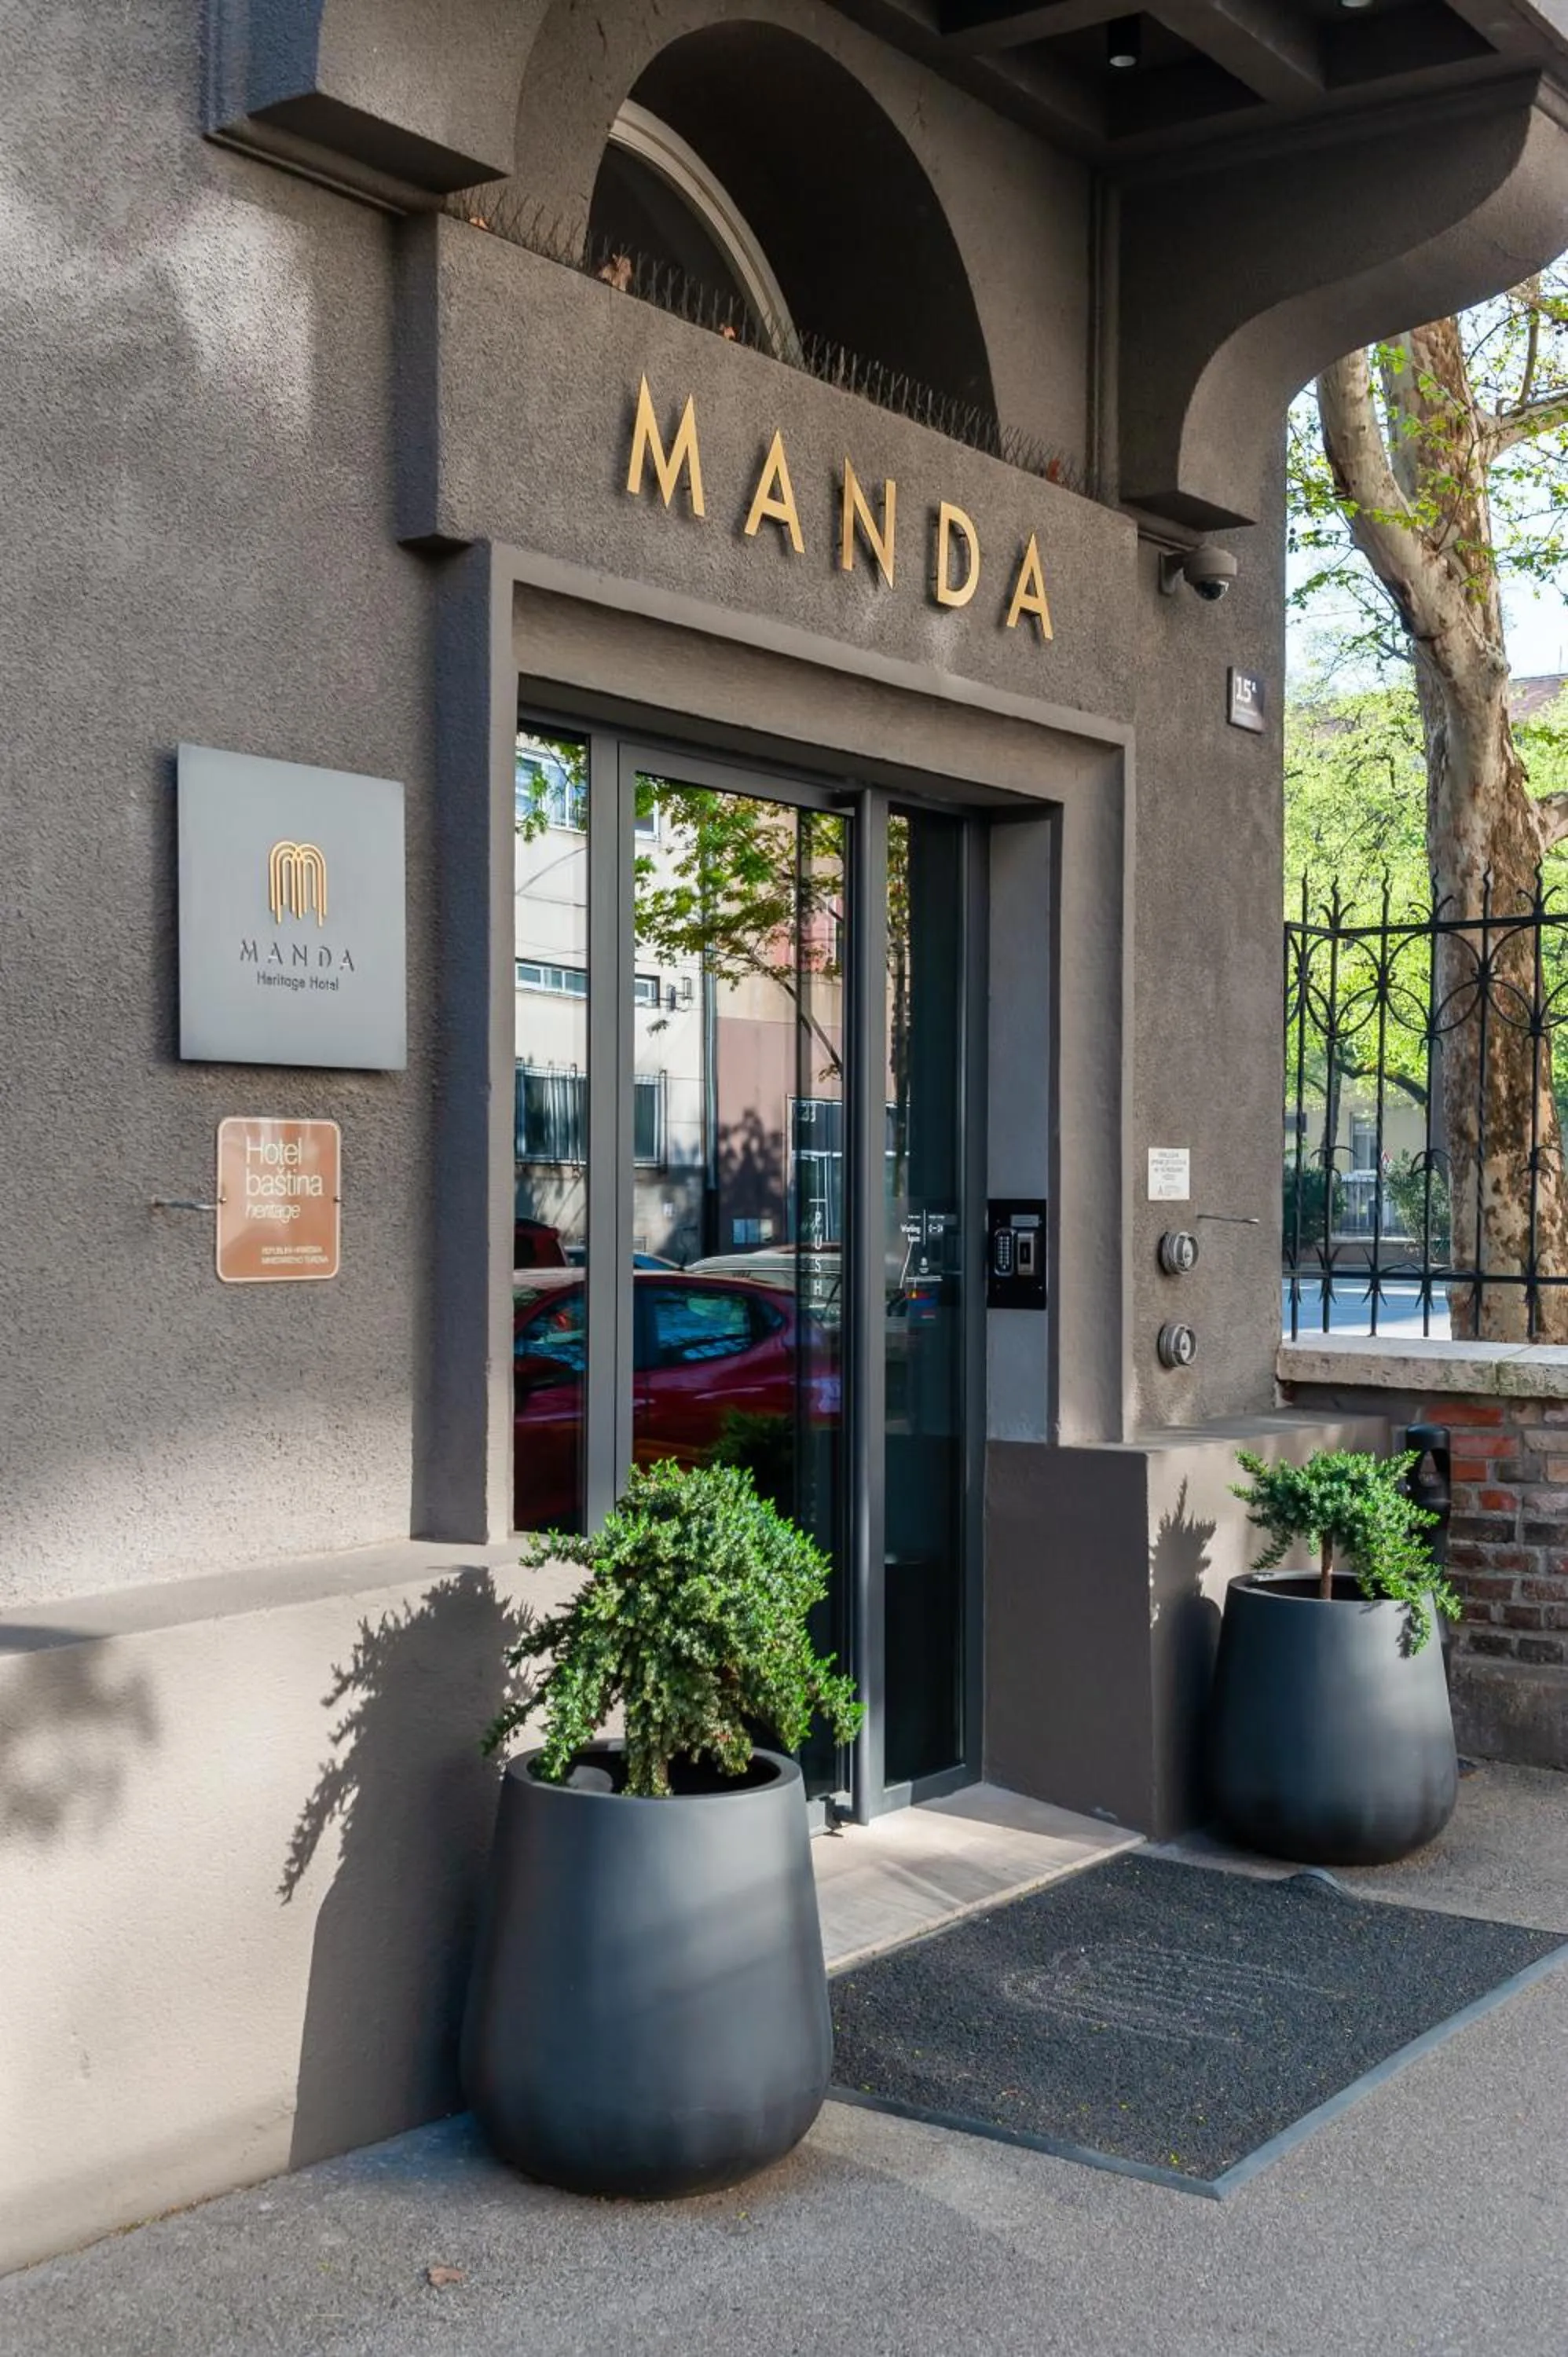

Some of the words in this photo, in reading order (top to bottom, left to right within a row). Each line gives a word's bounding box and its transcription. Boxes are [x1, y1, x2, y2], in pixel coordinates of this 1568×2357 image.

[625, 372, 1055, 642] MANDA
[239, 938, 356, 973] MANDA
[256, 971, 306, 991] Heritage
[310, 975, 339, 992] Hotel
[246, 1138, 302, 1166] Hotel
[246, 1166, 323, 1197] baština
[245, 1202, 301, 1223] heritage
